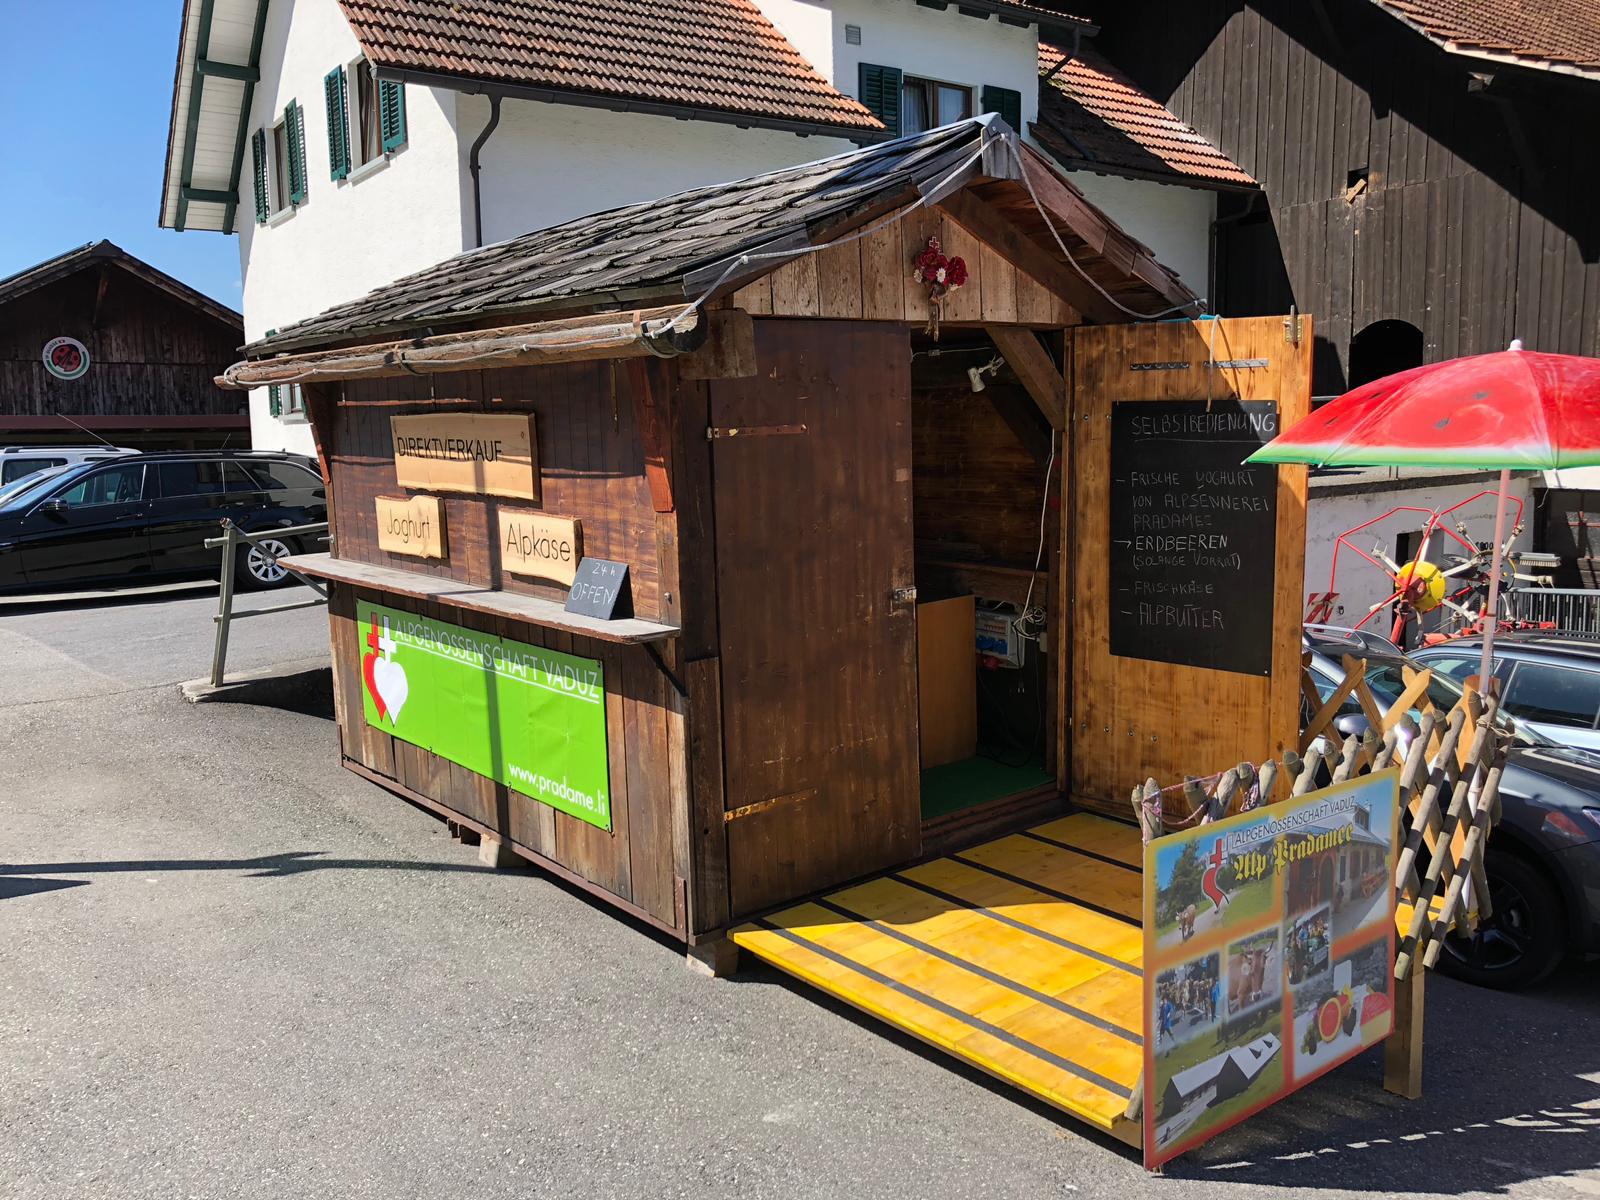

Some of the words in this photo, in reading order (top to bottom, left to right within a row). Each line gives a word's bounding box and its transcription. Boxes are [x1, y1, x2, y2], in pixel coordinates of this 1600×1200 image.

[1131, 412, 1275, 435] SELBSTBEDIENUNG
[397, 437, 502, 462] DIREKTVERKAUF
[1131, 471, 1181, 488] FRISCHE
[1195, 469, 1256, 489] YOGHURT
[1132, 494, 1152, 508] VON
[1164, 493, 1269, 512] ALPSENNEREI
[387, 509, 430, 543] Joghurt
[506, 523, 571, 563] Alpkäse
[1135, 534, 1228, 552] ERDBEEREN
[592, 562, 607, 577] 24
[571, 582, 616, 606] OFFEN
[1140, 601, 1224, 630] ALPBUTTER
[395, 621, 538, 681] ALPGENOSSENSCHAFT
[542, 661, 600, 699] VADUZ
[508, 762, 606, 816] www.pradame.li
[1234, 803, 1329, 844] ALPGENOSSENSCHAFT
[1329, 795, 1355, 814] VADUZ
[1234, 851, 1267, 881] Alp
[1272, 822, 1354, 875] Pradamee
